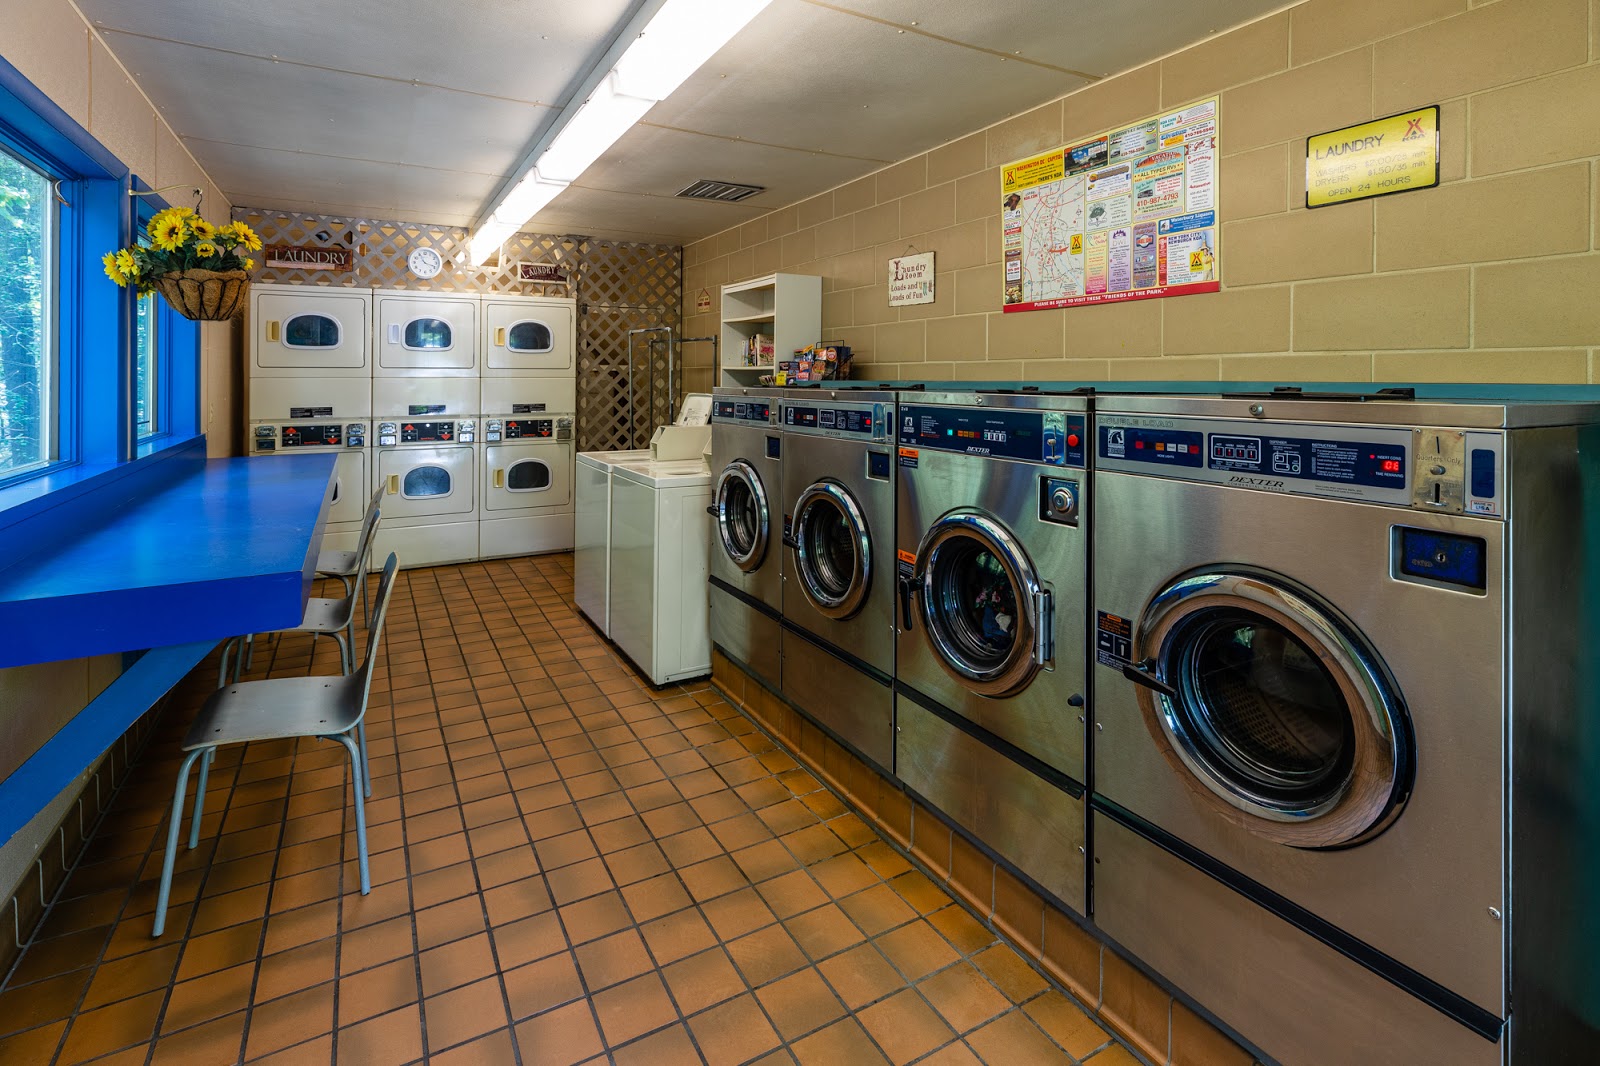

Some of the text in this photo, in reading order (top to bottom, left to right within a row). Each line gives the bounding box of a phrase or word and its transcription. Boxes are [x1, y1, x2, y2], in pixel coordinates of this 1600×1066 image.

[1402, 133, 1426, 142] KOA
[1316, 134, 1384, 160] LAUNDRY
[1017, 160, 1039, 171] WASHINGTON
[1189, 155, 1211, 164] Everything
[1315, 163, 1356, 178] WASHERS
[1315, 175, 1350, 187] DRYERS
[1328, 176, 1410, 197] OPEN 24 HOURS
[1137, 192, 1179, 207] 410-987-4793
[274, 249, 347, 265] LAUNDRY
[521, 266, 555, 279] LAUNDRY
[894, 260, 927, 281] Laundry
[905, 272, 922, 280] Room
[891, 283, 906, 291] Loads
[890, 293, 904, 301] Loads
[1099, 417, 1174, 428] DOUBLE LOAD
[1416, 454, 1442, 462] Quarters
[1230, 476, 1284, 488] DEXTER
